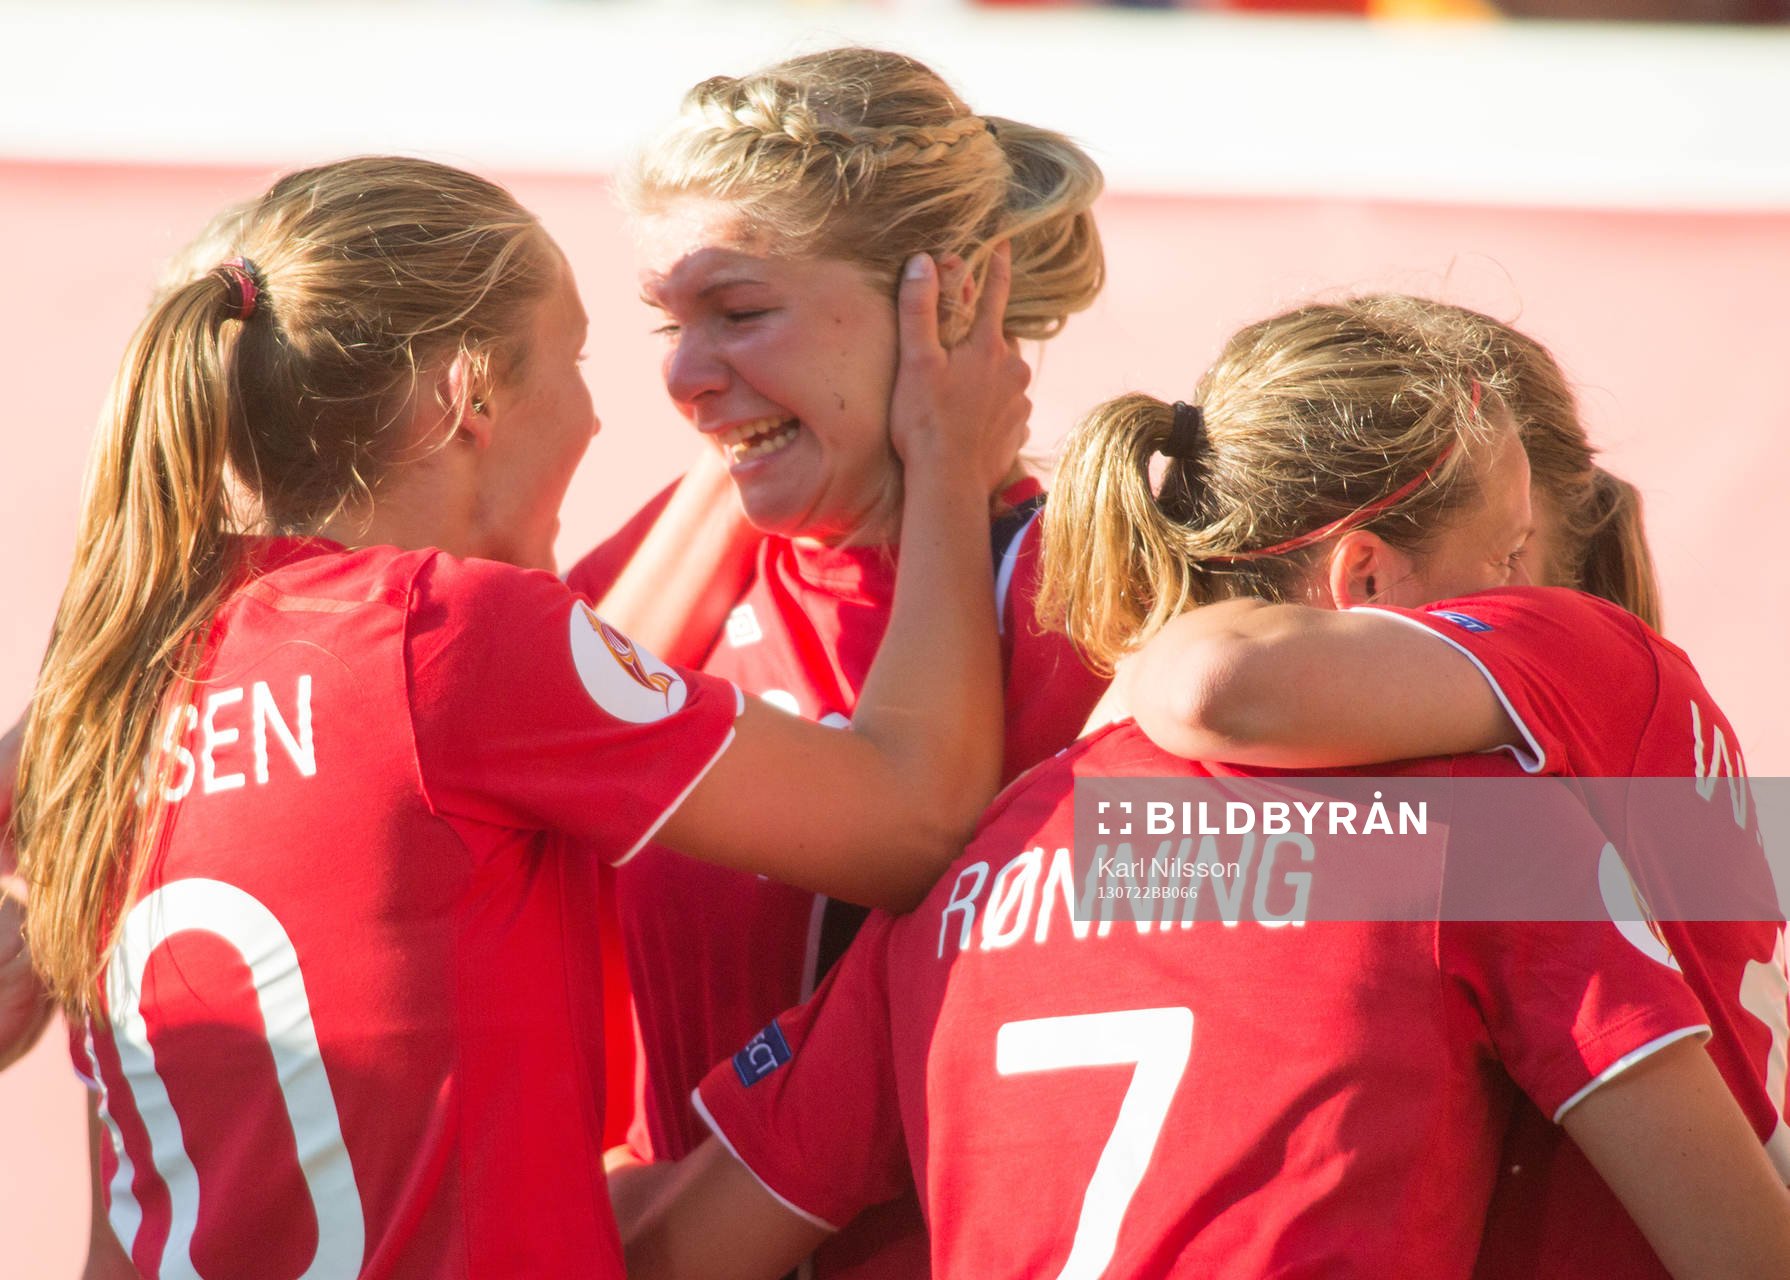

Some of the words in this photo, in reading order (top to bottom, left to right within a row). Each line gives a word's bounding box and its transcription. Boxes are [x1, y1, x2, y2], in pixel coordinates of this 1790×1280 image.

[134, 674, 317, 806] SEN
[937, 832, 1315, 959] RØNNING
[996, 1006, 1195, 1280] 7
